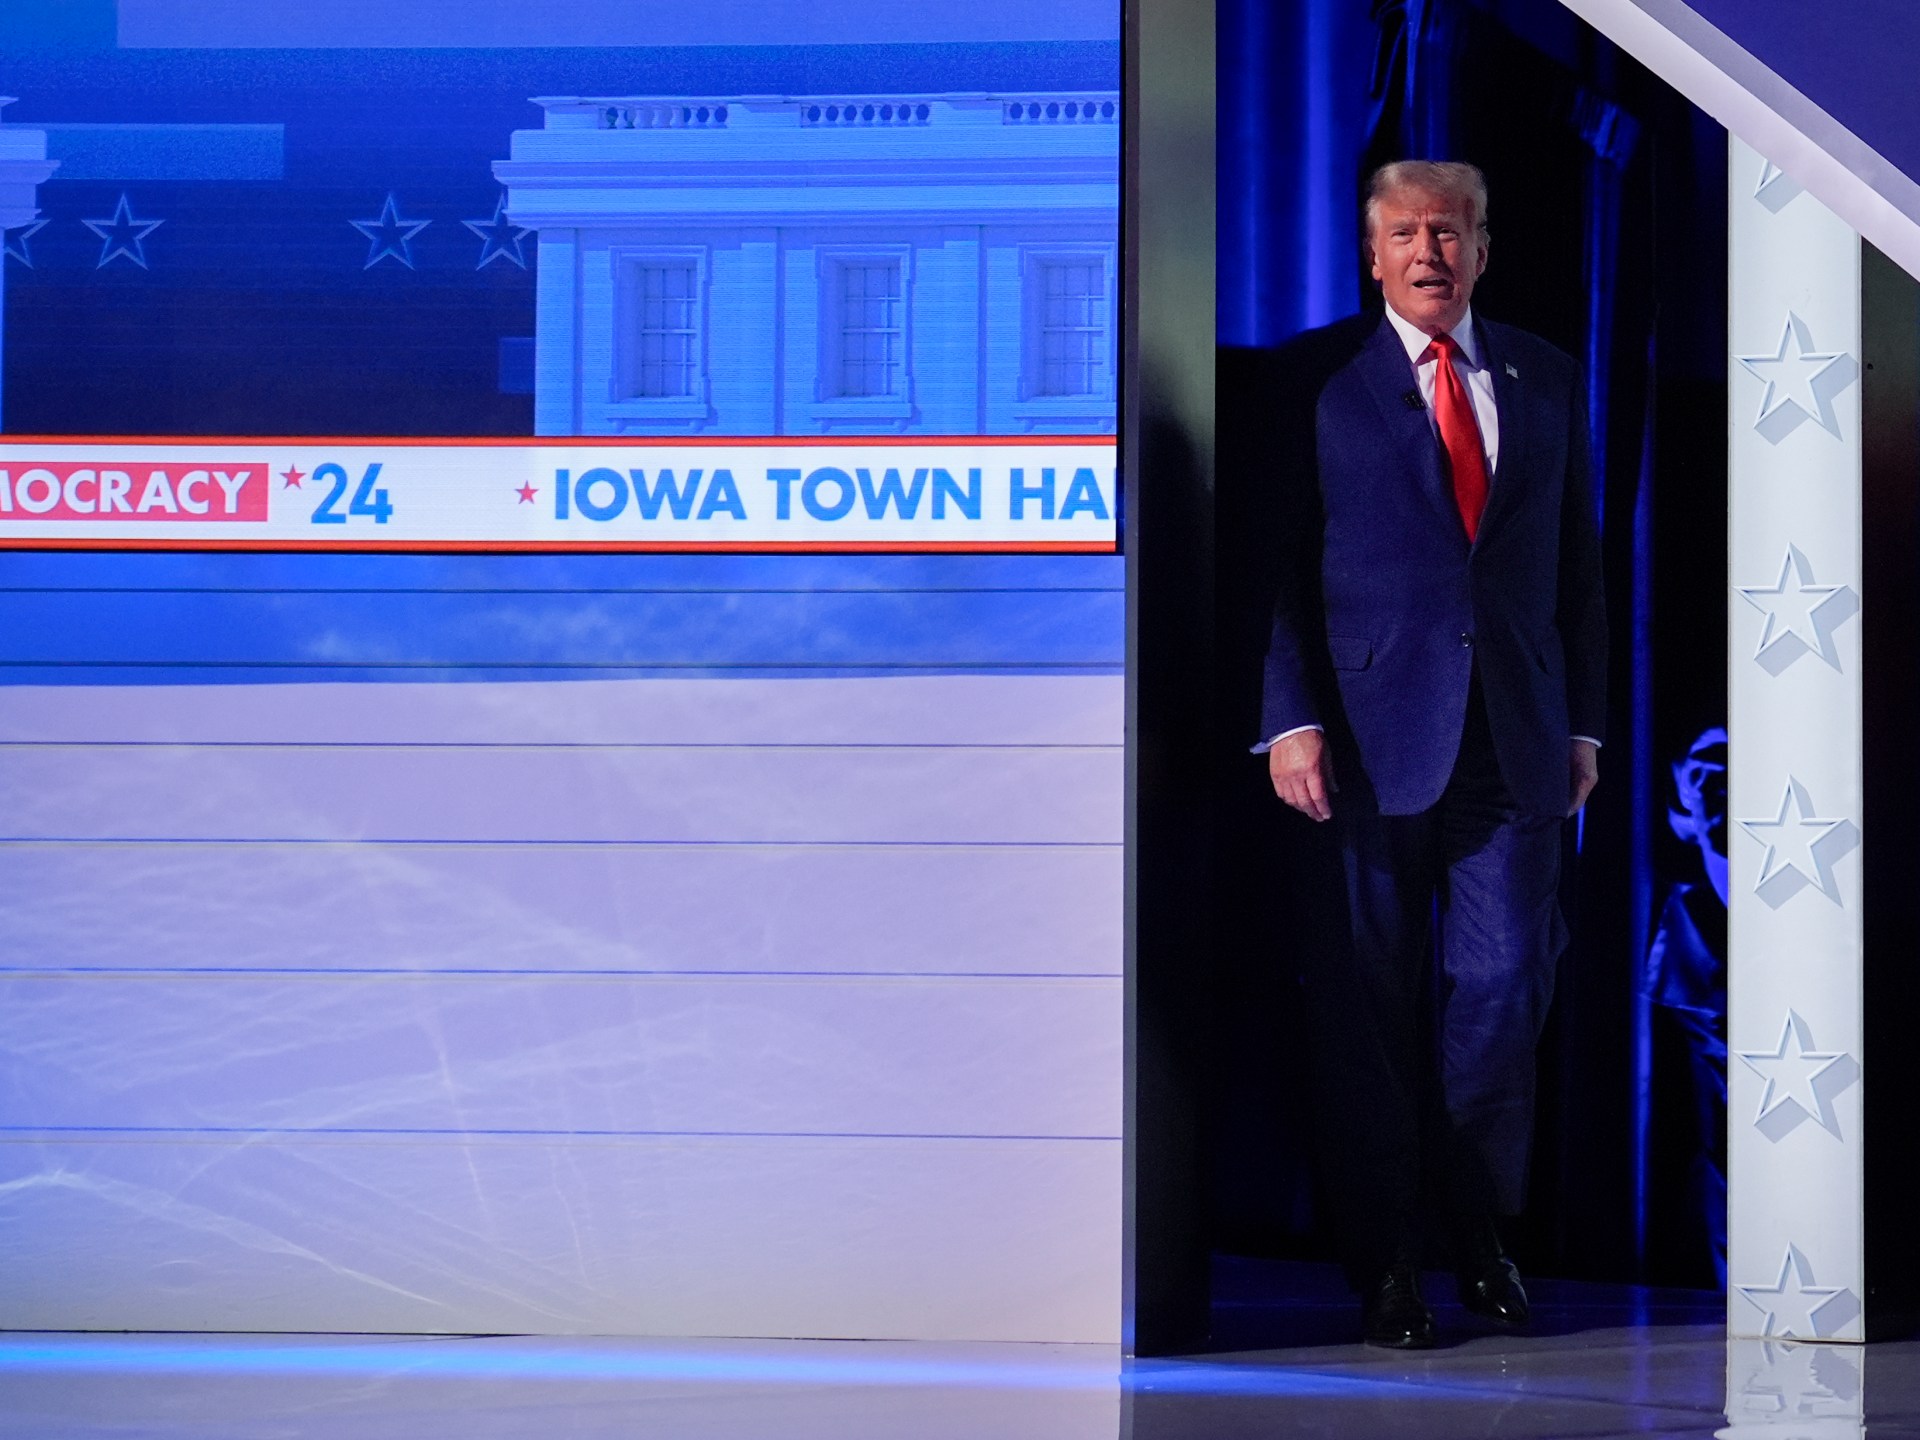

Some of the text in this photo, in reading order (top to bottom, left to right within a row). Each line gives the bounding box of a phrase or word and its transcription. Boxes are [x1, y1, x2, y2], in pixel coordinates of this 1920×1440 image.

[0, 462, 393, 524] OCRACY 24
[555, 467, 1117, 521] IOWA TOWN HA
